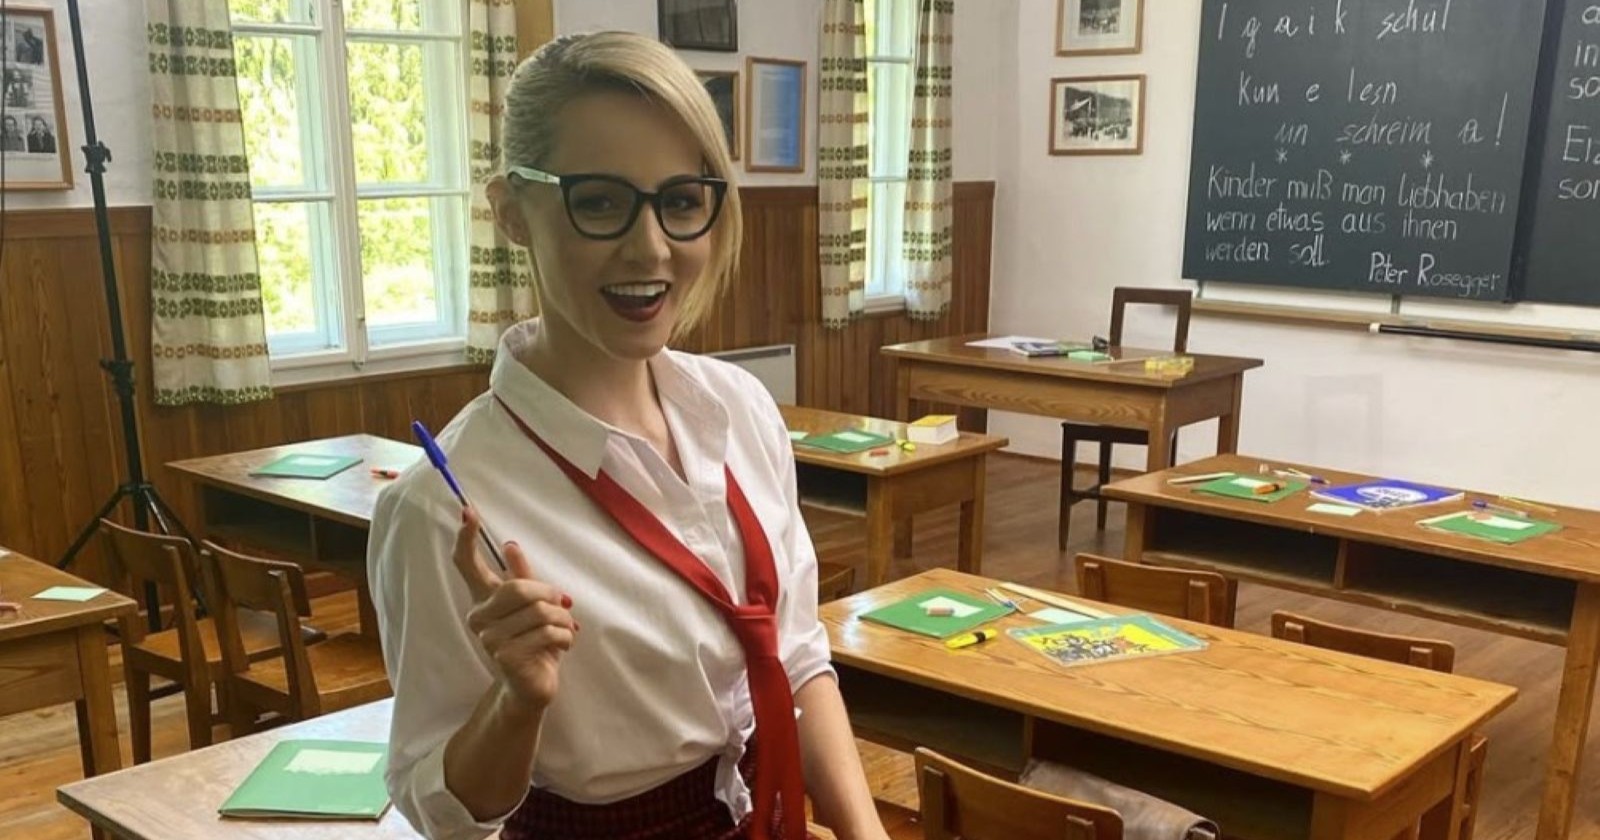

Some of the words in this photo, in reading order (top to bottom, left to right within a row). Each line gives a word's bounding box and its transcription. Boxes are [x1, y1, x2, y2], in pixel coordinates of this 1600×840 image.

[1305, 83, 1320, 102] e
[1208, 162, 1277, 199] Kinder
[1342, 181, 1386, 206] man
[1206, 211, 1256, 232] wenn
[1266, 201, 1325, 232] etwas
[1341, 211, 1387, 234] aus
[1402, 208, 1458, 241] ihnen
[1205, 236, 1270, 262] werden
[1368, 251, 1409, 285] Peter
[1417, 252, 1500, 297] Rosegger
